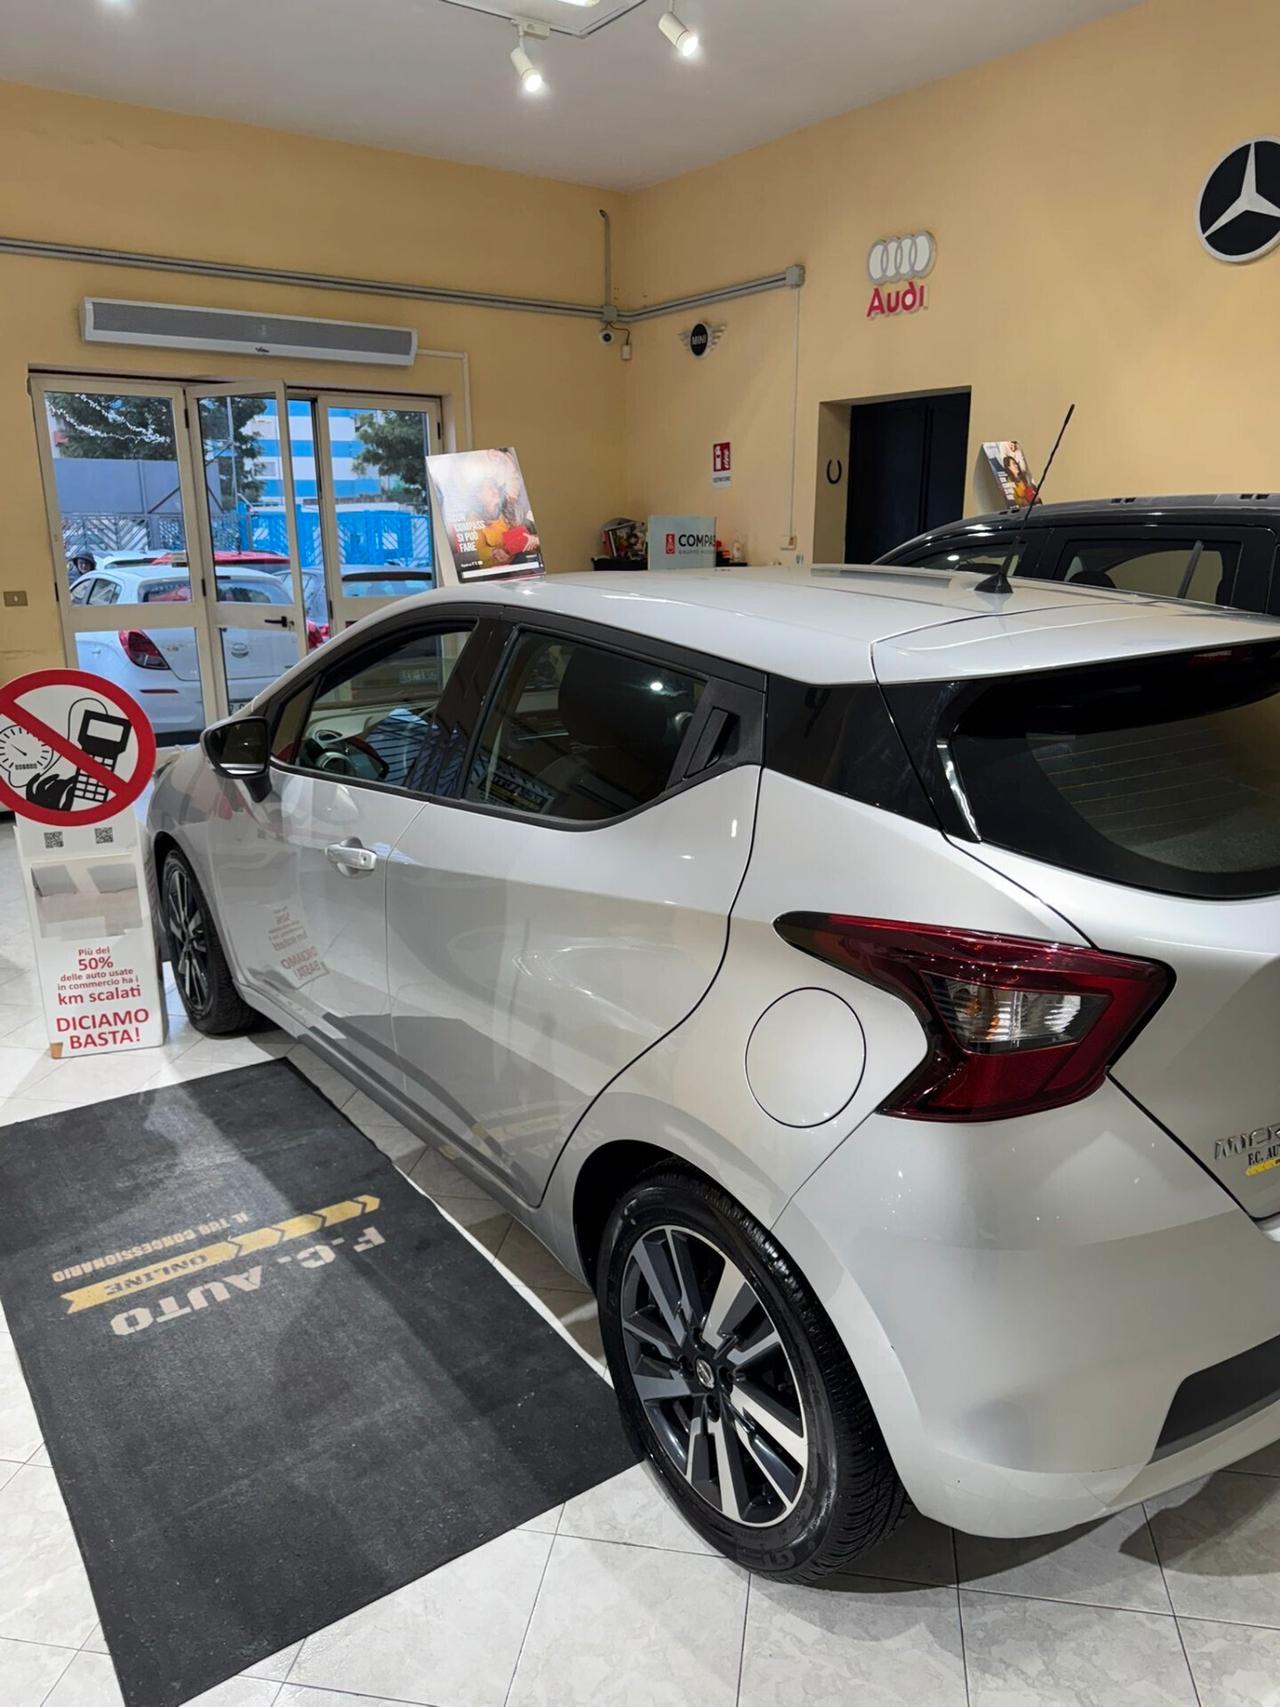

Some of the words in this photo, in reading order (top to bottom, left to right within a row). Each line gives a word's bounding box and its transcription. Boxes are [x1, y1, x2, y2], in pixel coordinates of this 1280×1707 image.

[867, 281, 925, 317] Audi
[78, 948, 93, 956] Più
[96, 946, 110, 955] del
[78, 956, 114, 971] 50%
[58, 983, 66, 991] in
[69, 978, 120, 990] commercio
[122, 976, 133, 984] ha
[60, 973, 83, 982] delle
[86, 971, 107, 979] auto
[109, 968, 134, 977] usate
[58, 993, 84, 1006] km
[89, 984, 141, 1003] scalati
[56, 1008, 149, 1032] DICIAMO
[69, 1027, 141, 1050] BASTA!
[198, 1218, 231, 1236] TUO
[231, 1211, 249, 1224] IL
[51, 1229, 197, 1283] CONCESSIONARIO
[103, 1254, 208, 1296] ONLINE
[110, 1264, 262, 1336] AUTO
